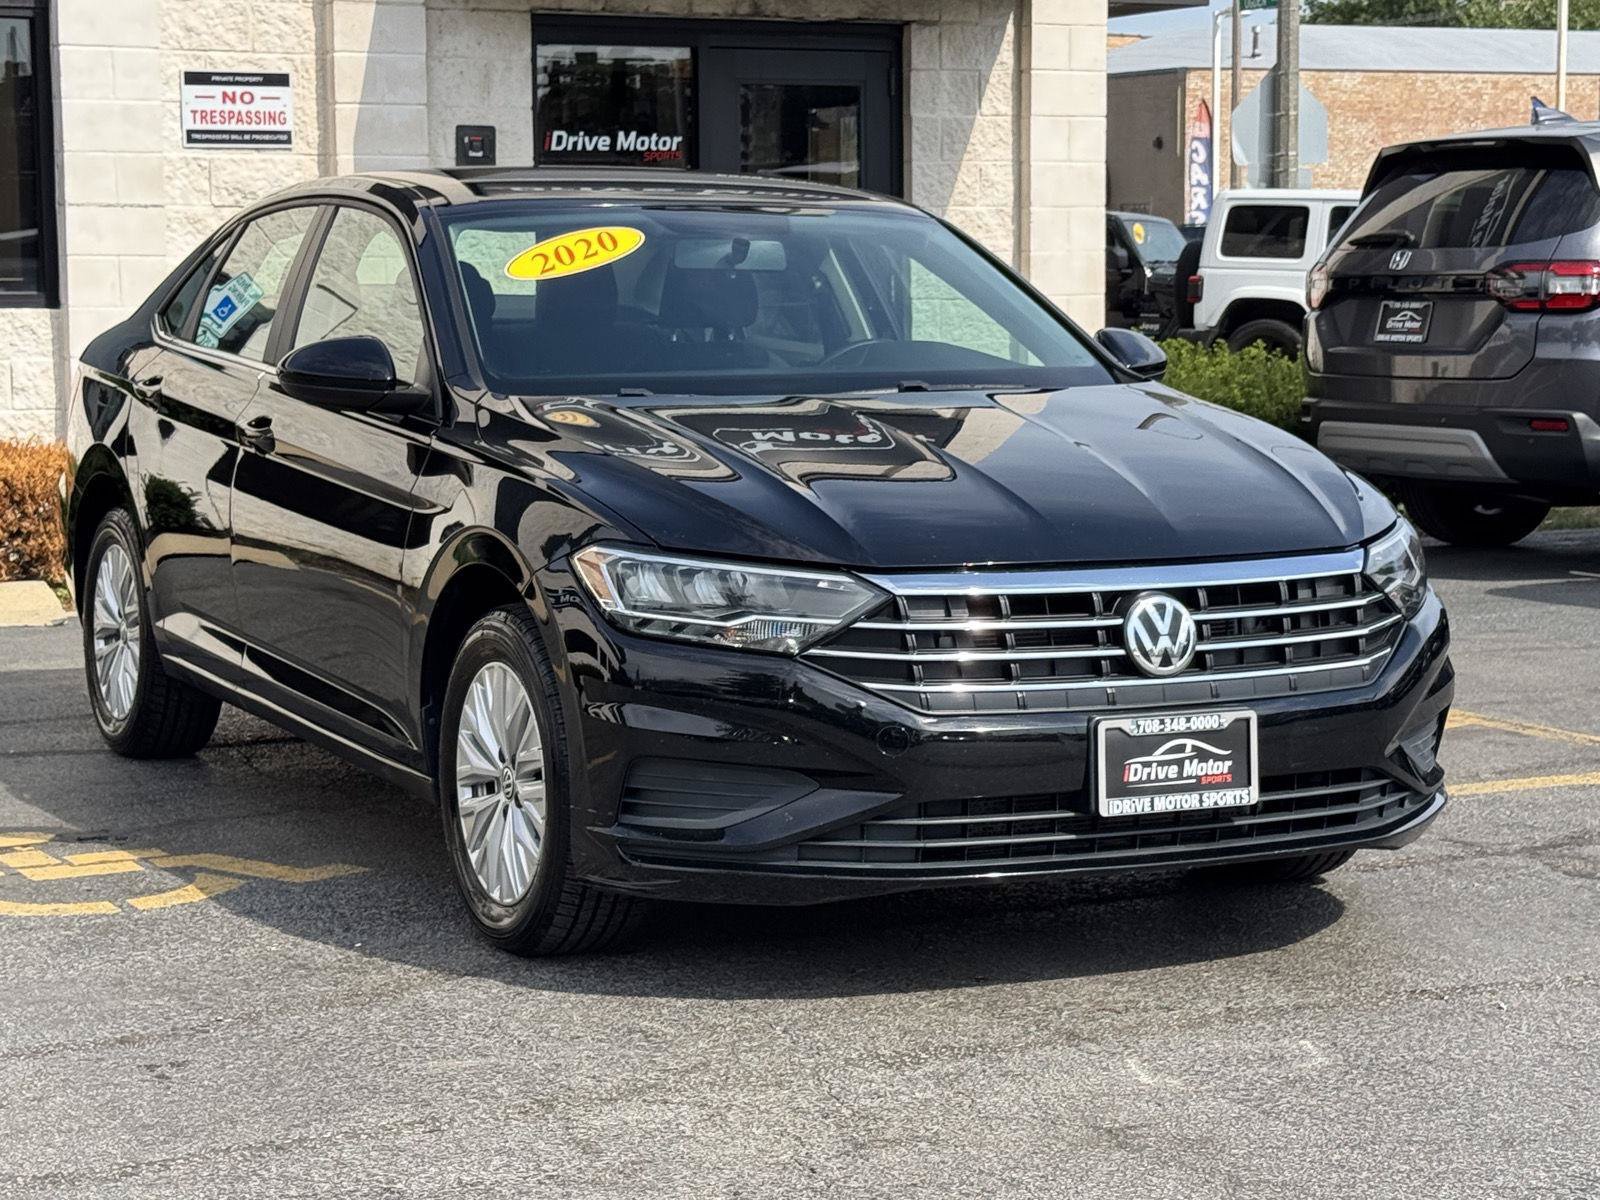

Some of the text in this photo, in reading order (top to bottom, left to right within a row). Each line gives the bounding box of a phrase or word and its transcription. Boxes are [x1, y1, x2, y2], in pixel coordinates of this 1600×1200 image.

[222, 91, 254, 105] NO
[190, 109, 287, 126] TRESPASSING
[544, 130, 682, 151] iDrive Motor
[643, 151, 684, 161] SPORTS
[531, 231, 619, 275] 2020
[1137, 714, 1220, 734] 708-348-0000
[1182, 758, 1233, 778] Motor
[1200, 773, 1233, 784] SPORTS
[1153, 793, 1200, 812] MOTOR
[1201, 789, 1250, 807] SPORTS
